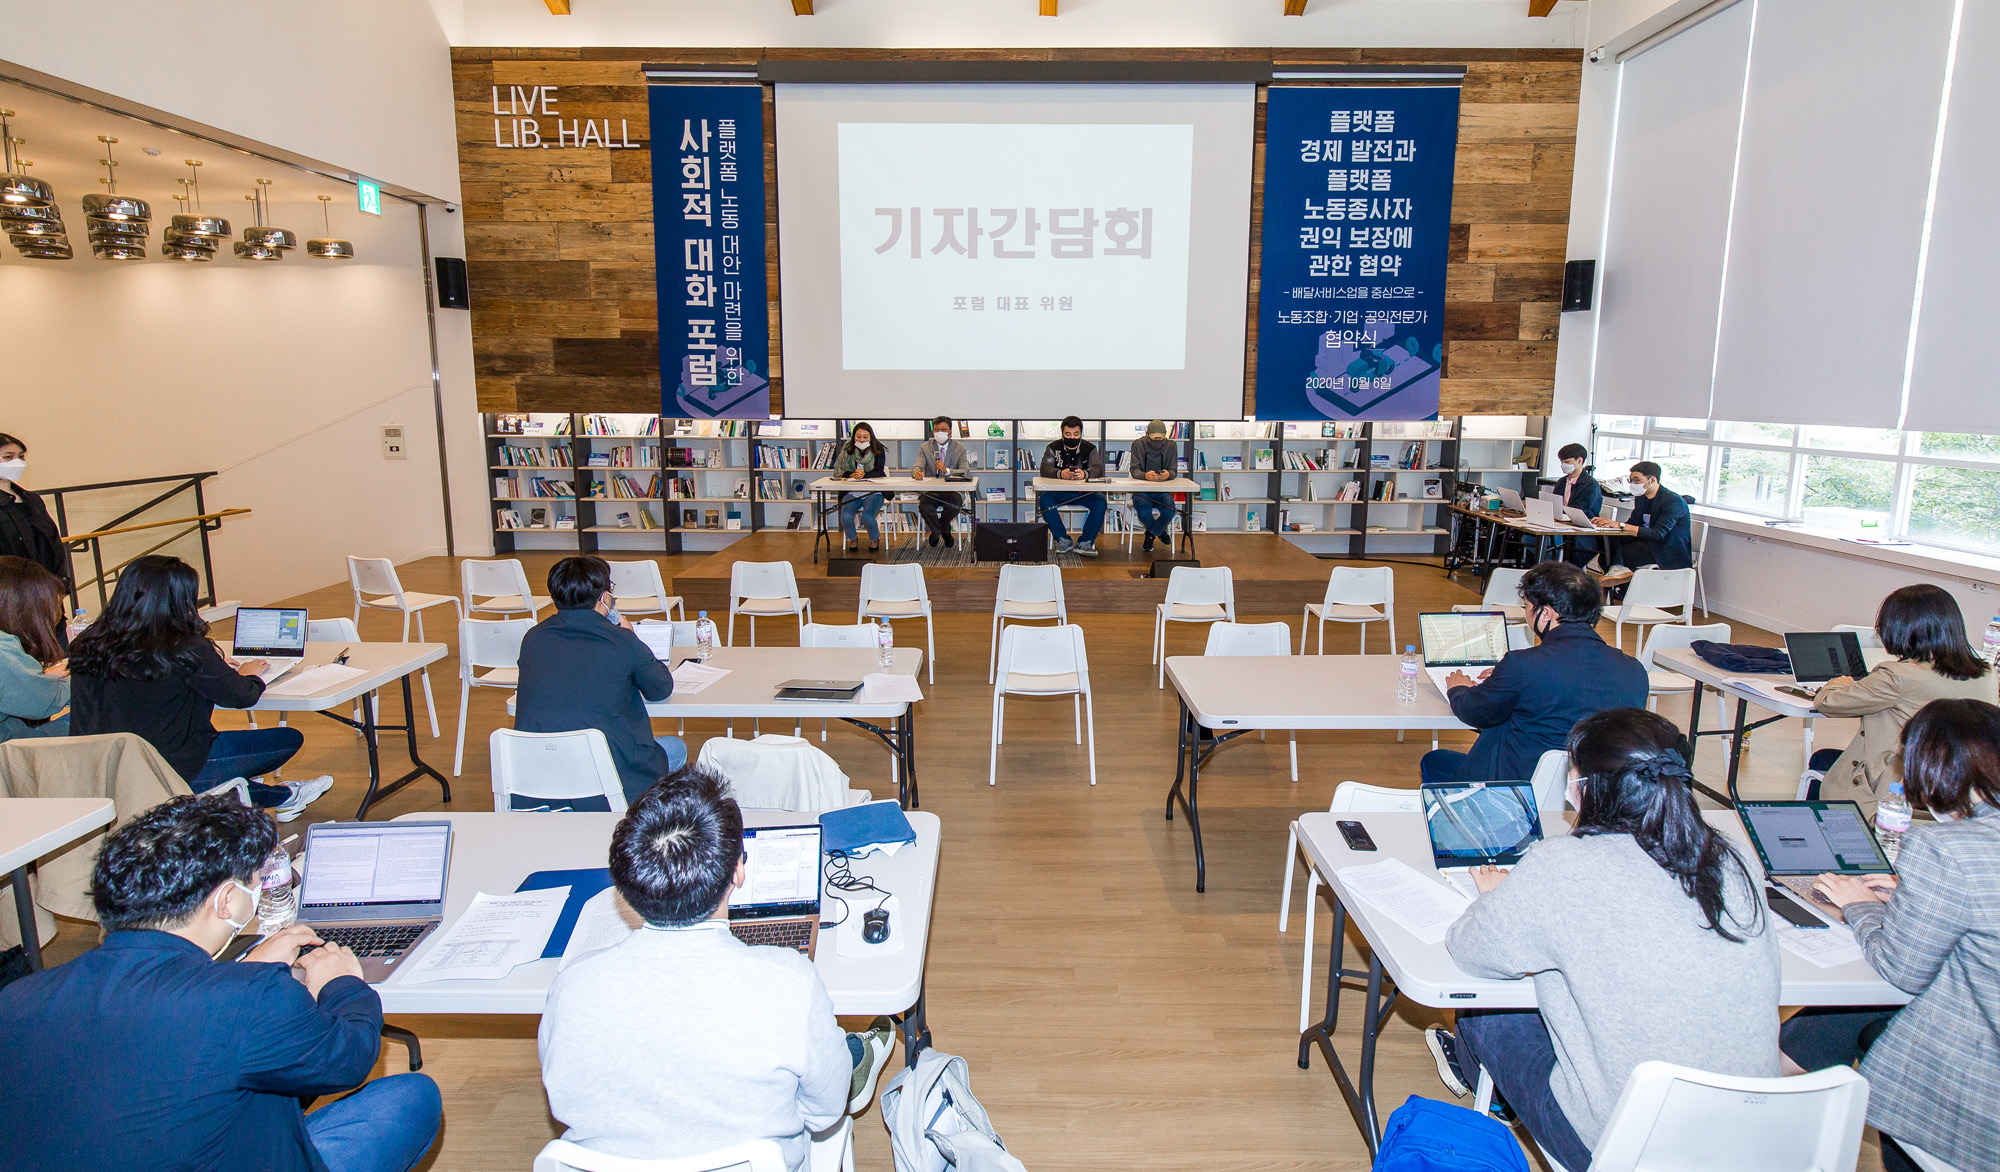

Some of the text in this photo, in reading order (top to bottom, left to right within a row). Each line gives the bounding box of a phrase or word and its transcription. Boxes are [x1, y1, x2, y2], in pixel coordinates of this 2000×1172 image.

[492, 85, 560, 116] LIVE
[1330, 110, 1396, 133] 플랫폼
[494, 118, 641, 149] LIB. HALL
[1300, 139, 1417, 163] 경제 발전과
[1327, 169, 1392, 192] 플랫폼
[1303, 198, 1413, 221] 노동종사자
[873, 206, 1153, 260] 기자간담회
[1299, 226, 1413, 249] 권익 보장에
[680, 118, 718, 386] 사회적 대화 포럼
[718, 119, 743, 386] 플랫폼 노동 대안 마련을 위한
[1309, 254, 1402, 277] 관한 협약
[952, 296, 1073, 312] 포럼 대표 위원
[1292, 286, 1369, 299] 배달서비스업을
[1371, 286, 1415, 299] 중심으로
[1325, 330, 1377, 349] 협약식
[1305, 376, 1392, 390] 2020년 10월 6일
